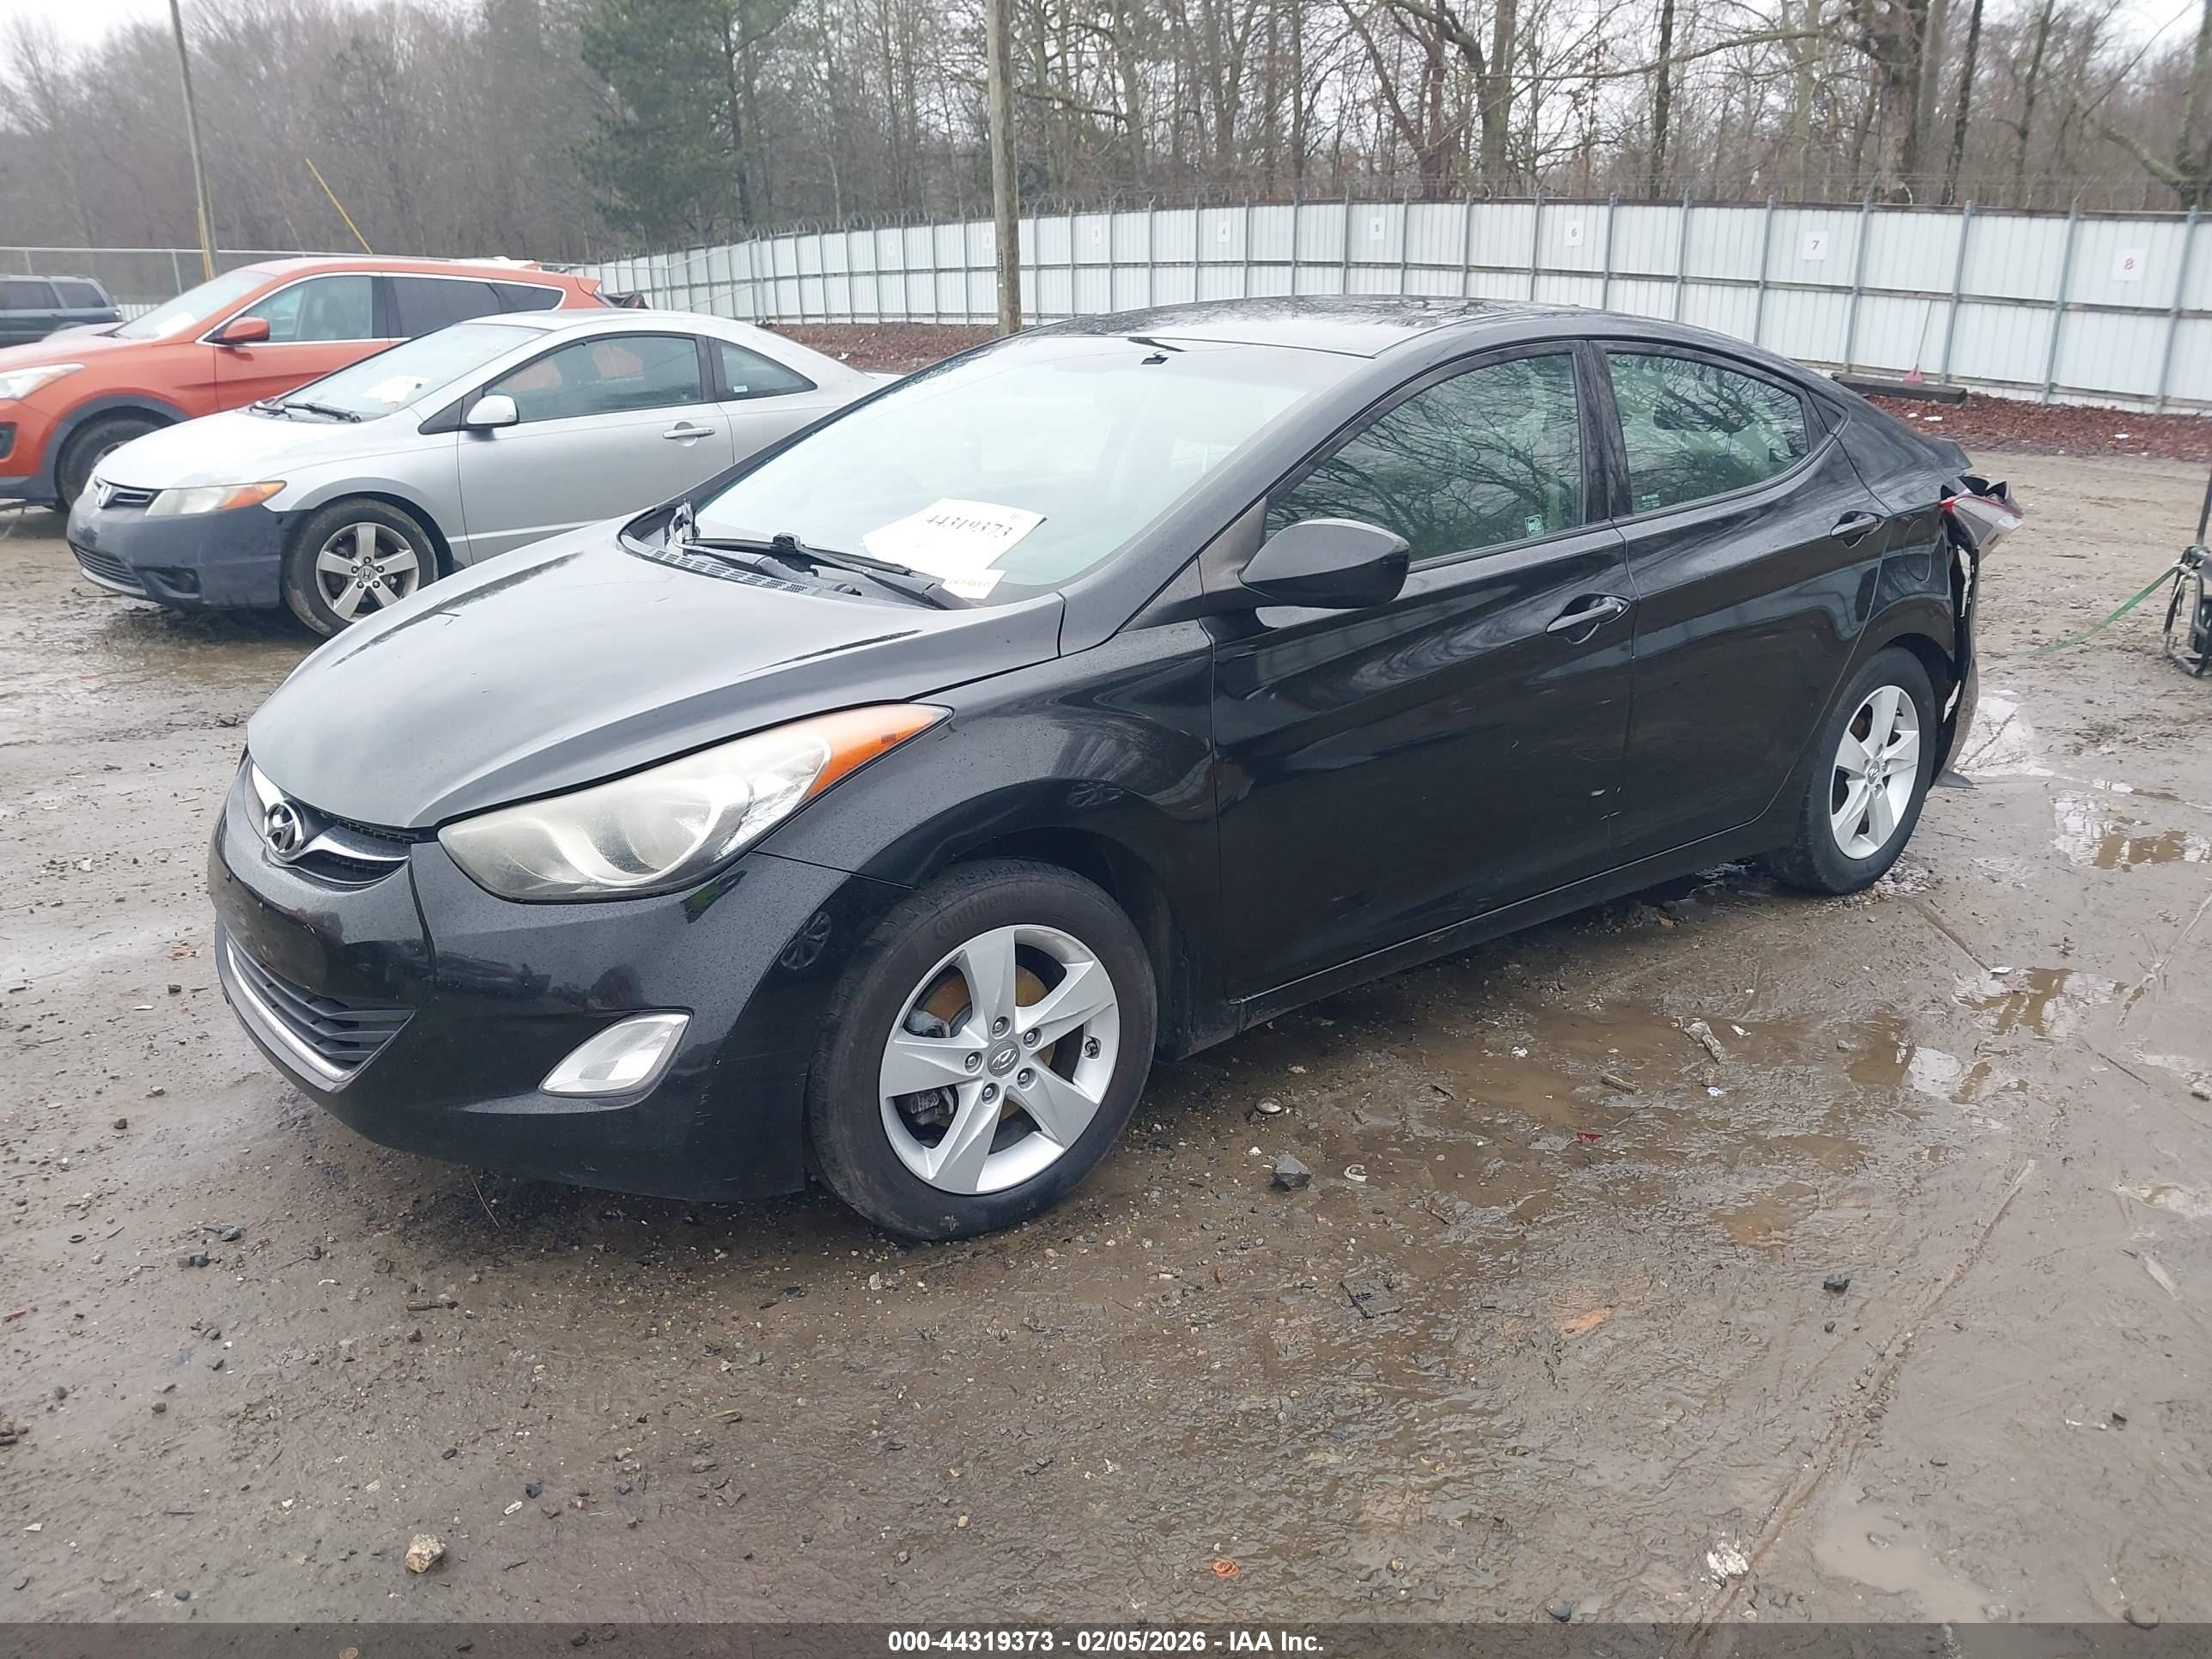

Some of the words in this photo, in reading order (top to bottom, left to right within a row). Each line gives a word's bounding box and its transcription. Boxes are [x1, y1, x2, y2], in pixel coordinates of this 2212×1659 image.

[1571, 228, 1577, 238] 6
[1812, 240, 1820, 250] 7
[2124, 258, 2135, 270] 8
